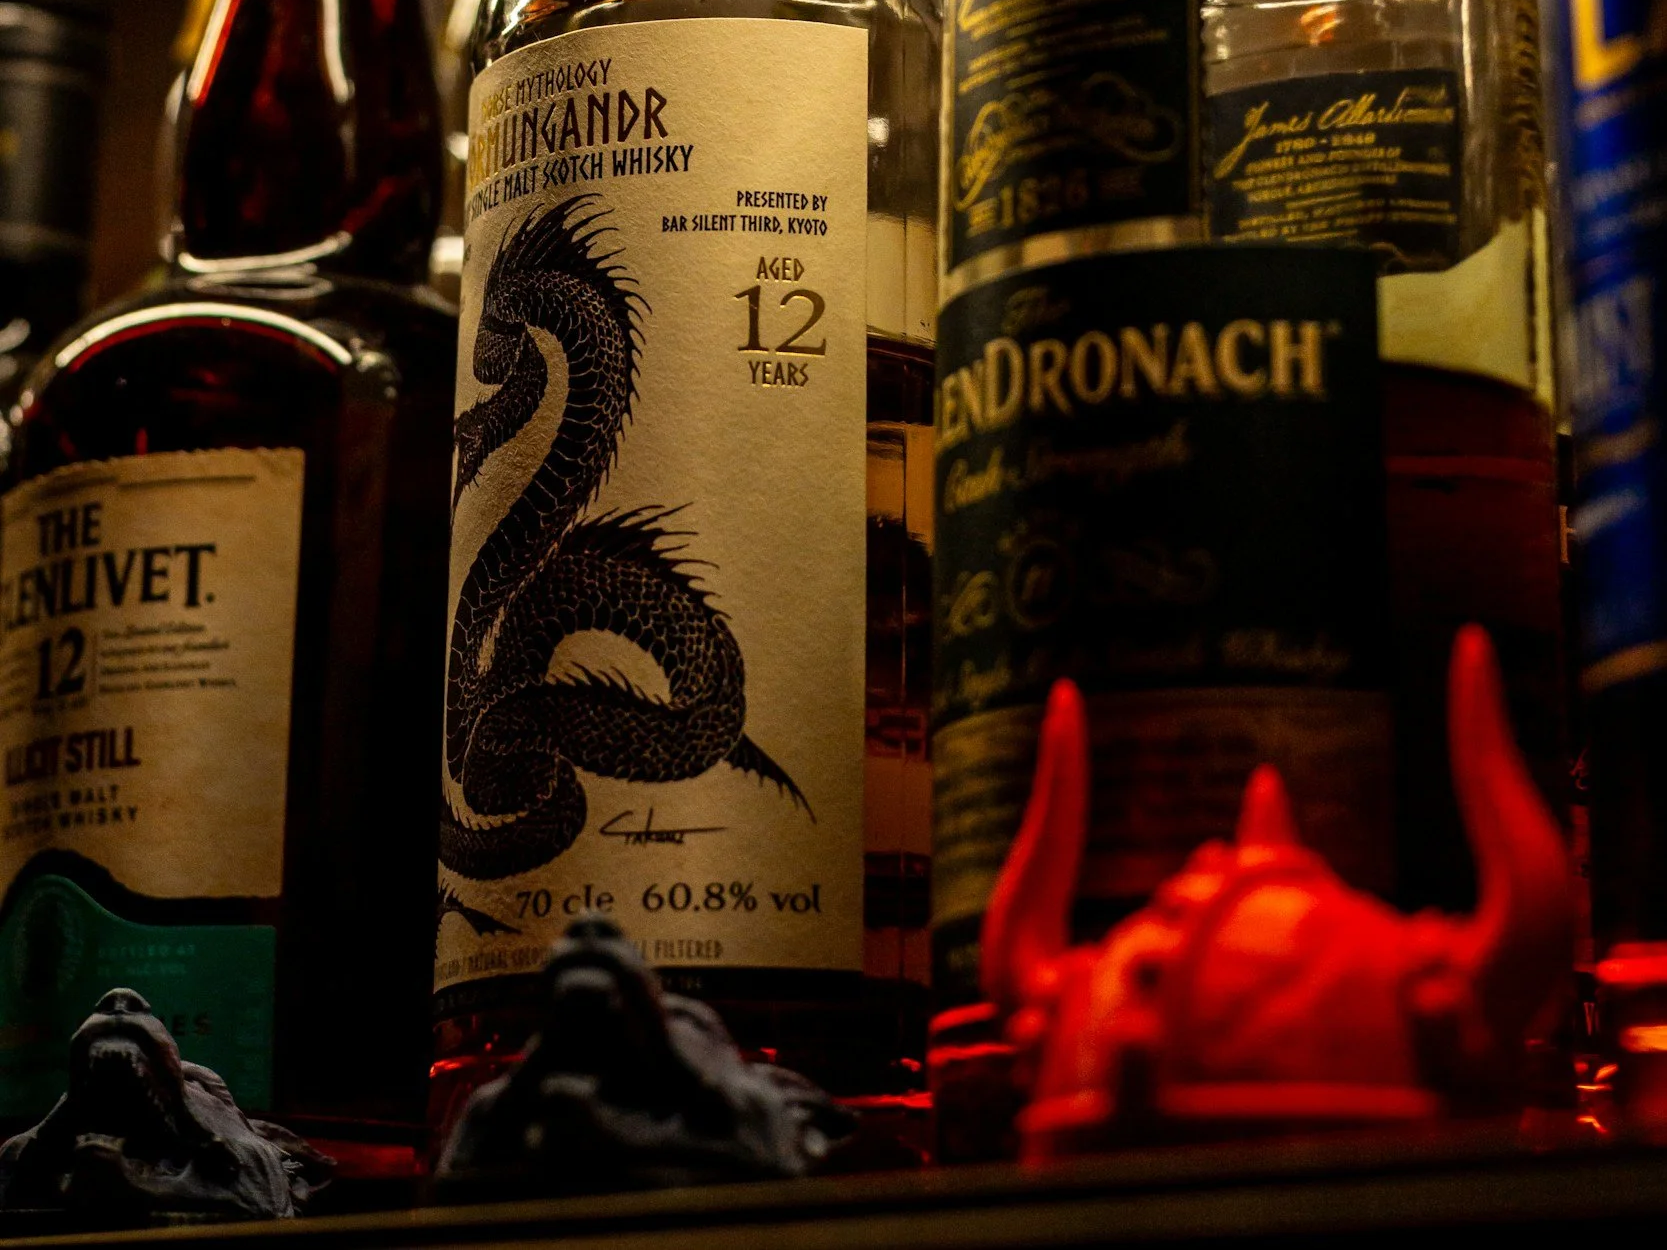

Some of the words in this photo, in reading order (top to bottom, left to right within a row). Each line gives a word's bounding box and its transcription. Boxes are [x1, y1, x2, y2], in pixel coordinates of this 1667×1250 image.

[516, 58, 612, 107] MYTHOLOGY
[503, 165, 539, 202] MALT
[542, 152, 603, 189] SCOTCH
[612, 144, 694, 177] WHISKY
[736, 190, 809, 211] PRESENTED
[811, 195, 828, 212] BY
[661, 216, 688, 232] BAR
[692, 215, 735, 232] SILENT
[740, 218, 783, 235] THIRD,
[788, 218, 828, 236] KYOTO
[755, 256, 805, 282] AGED
[733, 286, 827, 357] 12
[749, 361, 809, 387] YEARS
[37, 502, 103, 556] THE
[37, 626, 86, 699] 12
[66, 726, 141, 771] STILL
[59, 805, 137, 828] WHISKY
[516, 889, 551, 919] 70
[641, 882, 758, 913] 60.8%
[771, 884, 822, 913] vol
[654, 939, 723, 961] FILTERED
